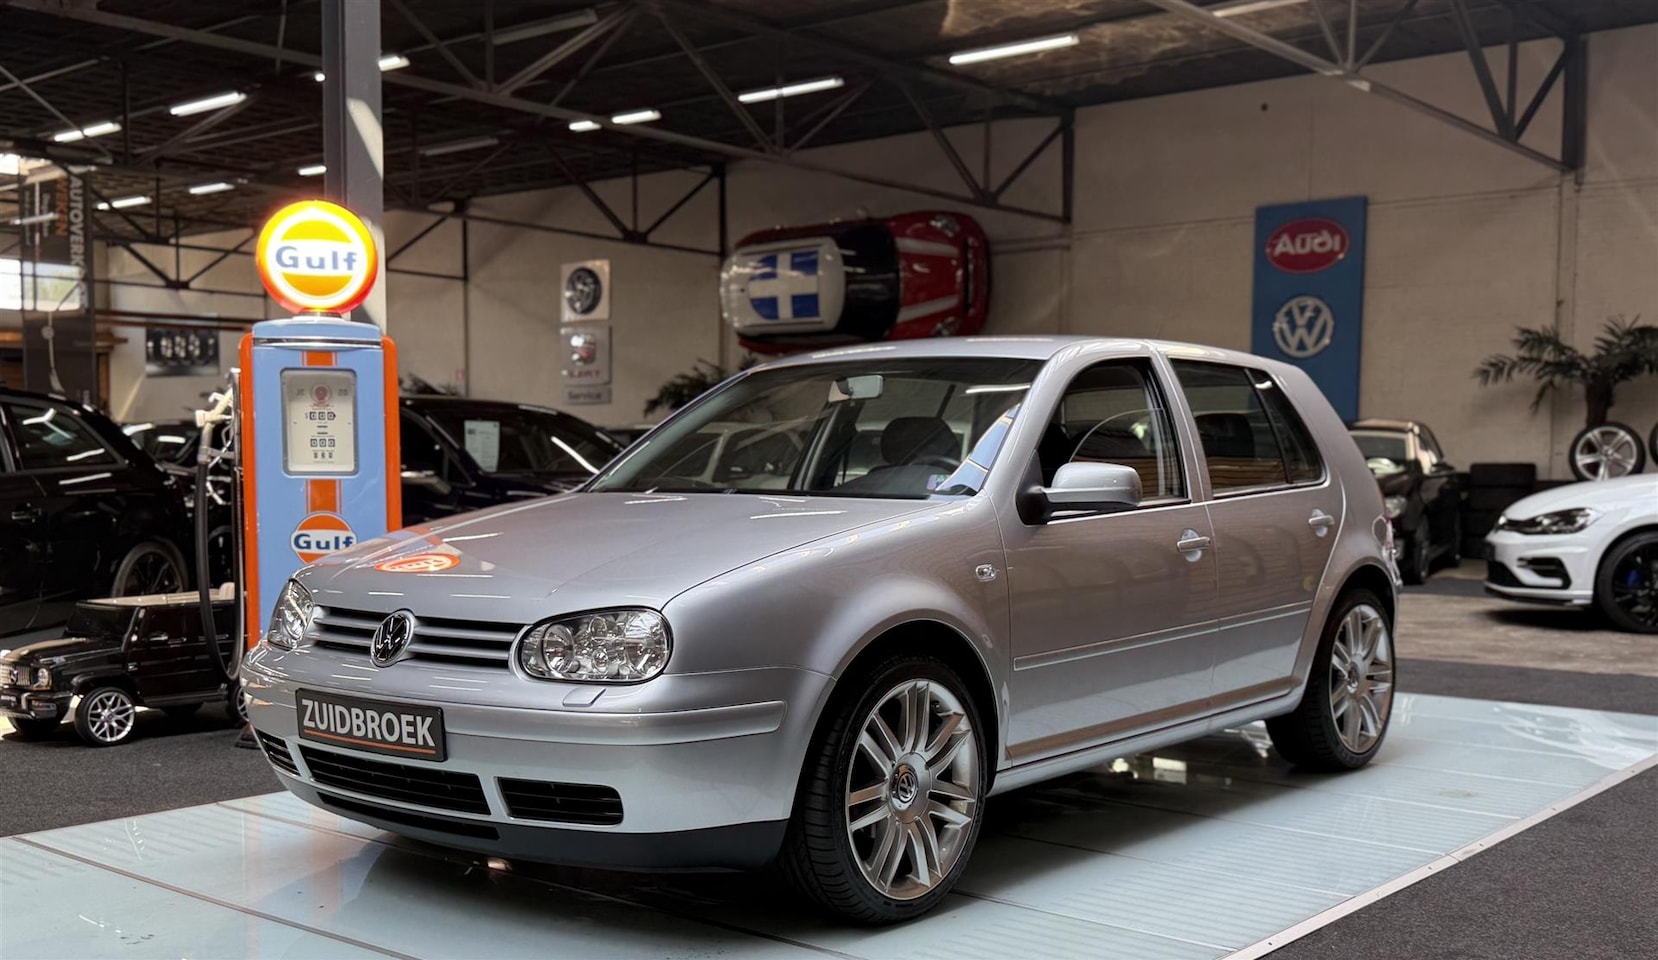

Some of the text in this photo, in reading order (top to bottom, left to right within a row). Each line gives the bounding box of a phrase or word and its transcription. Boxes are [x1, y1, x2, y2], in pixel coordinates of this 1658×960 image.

[275, 245, 357, 271] Gulf
[293, 533, 354, 550] Gulf
[301, 698, 436, 747] ZUIDBROEK
